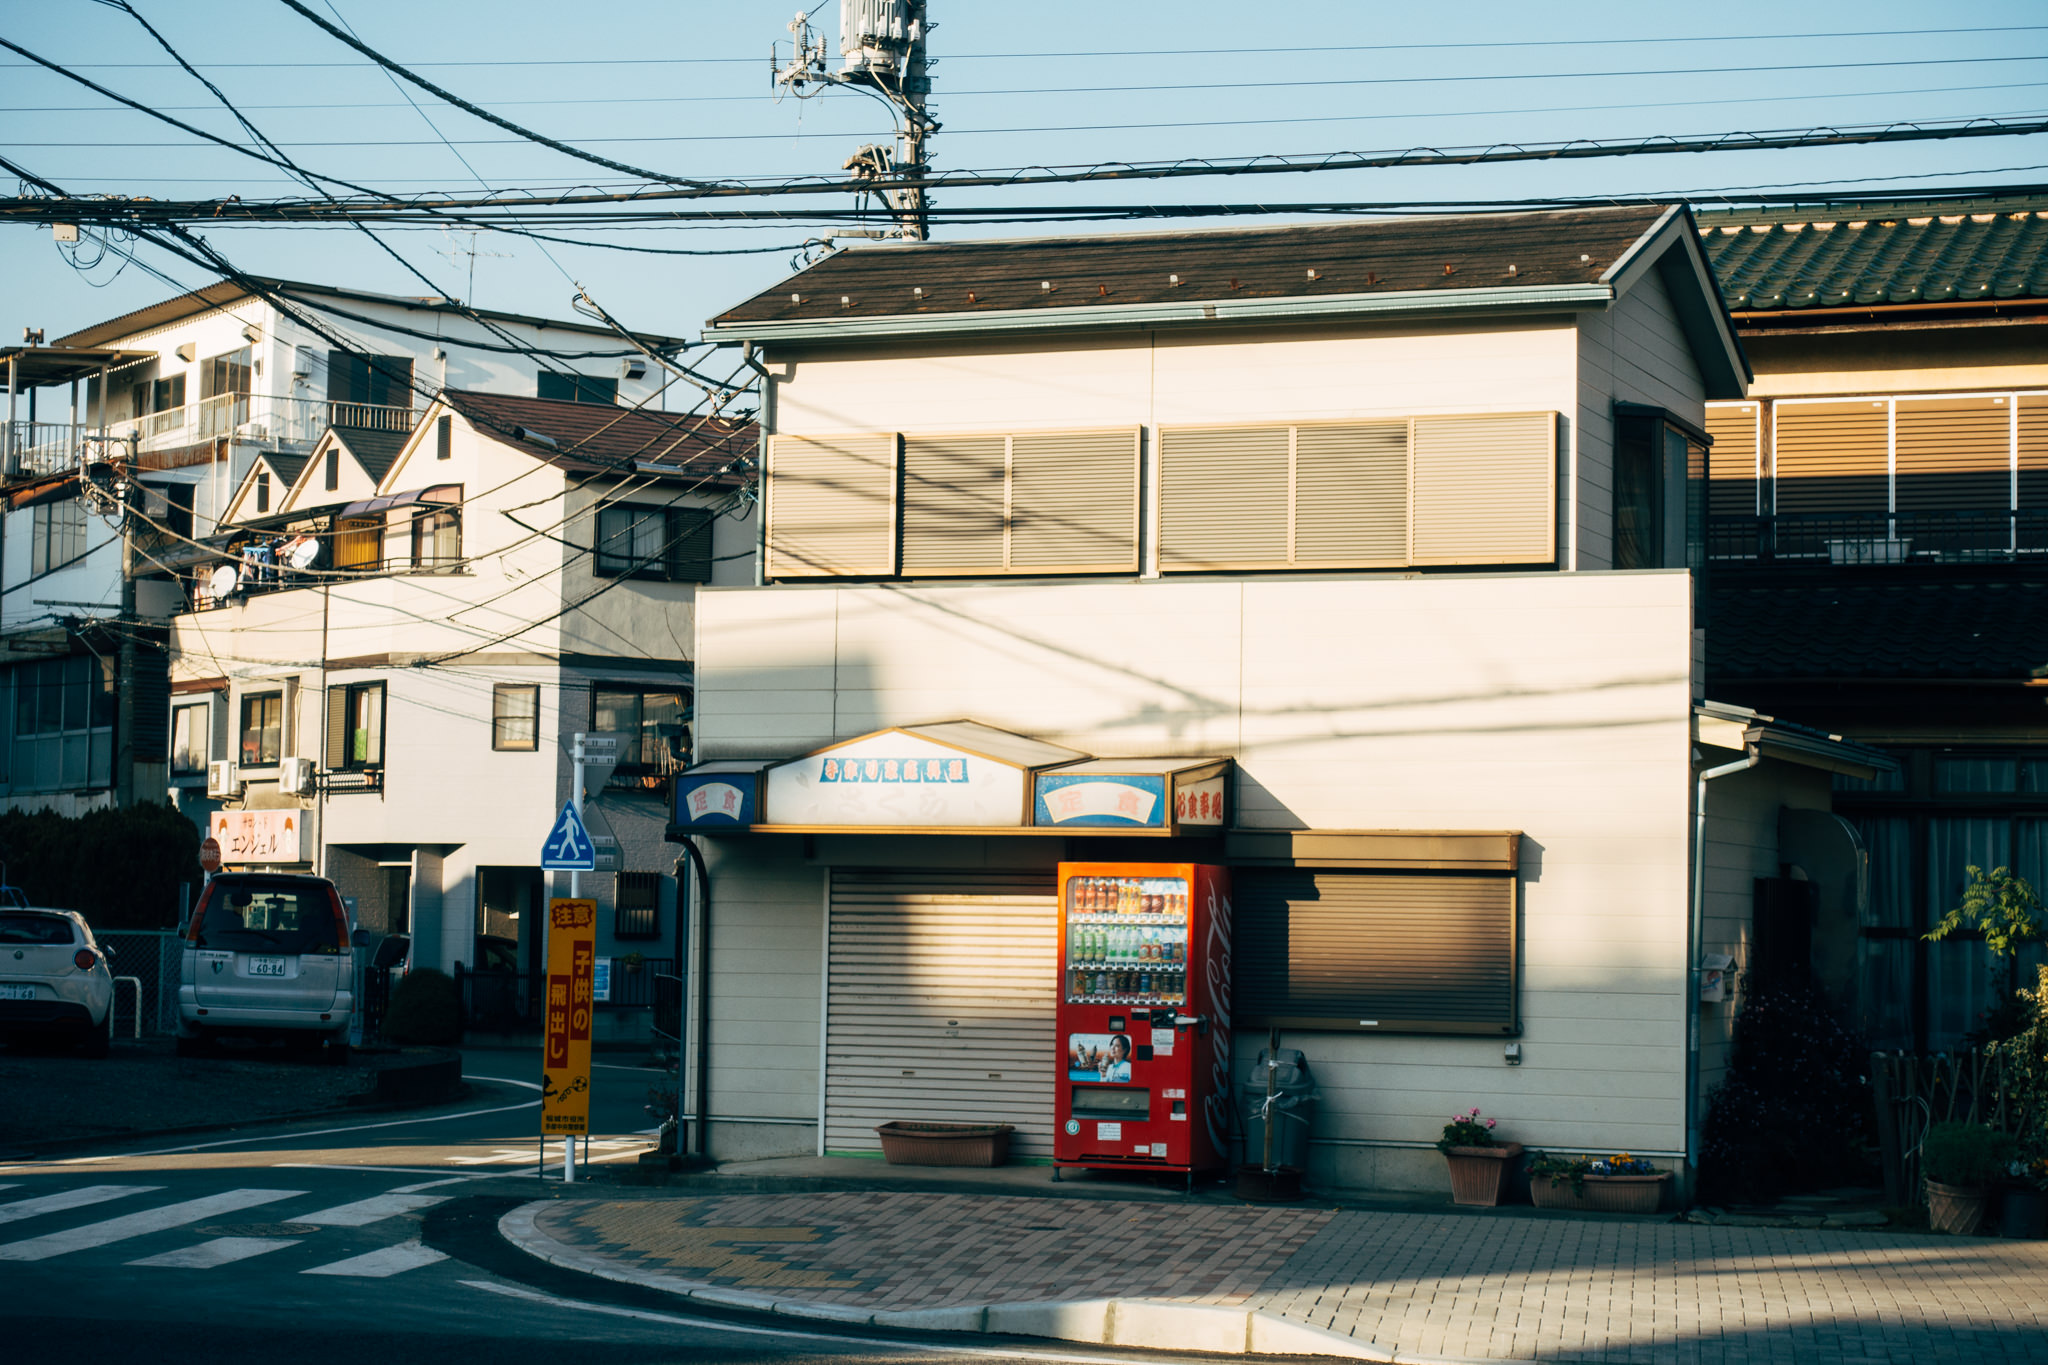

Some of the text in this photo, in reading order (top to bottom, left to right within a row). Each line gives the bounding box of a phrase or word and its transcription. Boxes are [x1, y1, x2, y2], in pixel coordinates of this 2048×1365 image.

[824, 759, 963, 781] 手作り家庭料理
[694, 790, 736, 813] 定食
[1058, 790, 1140, 815] 定食
[231, 833, 278, 855] エンジェル
[555, 906, 590, 925] 注意
[573, 950, 591, 1031] 子供の
[550, 983, 567, 1059] 飛出し
